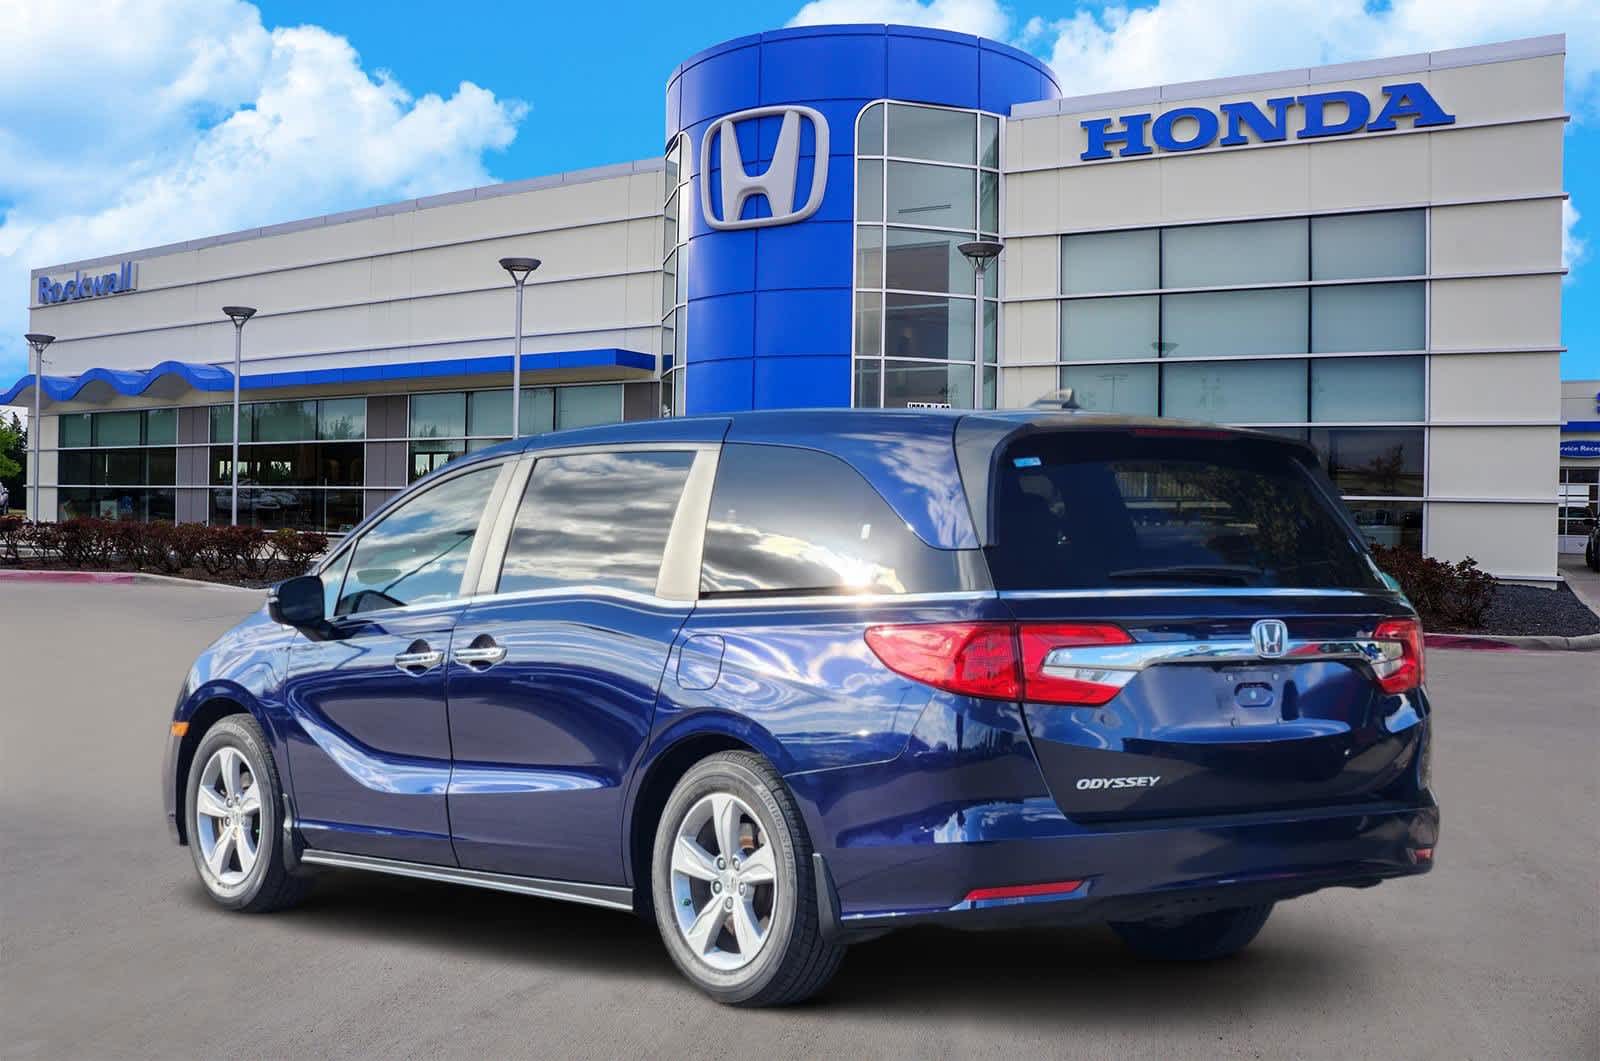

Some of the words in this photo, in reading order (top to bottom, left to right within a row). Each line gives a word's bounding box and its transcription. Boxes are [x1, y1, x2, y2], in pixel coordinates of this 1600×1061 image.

[1080, 82, 1456, 161] HONDA
[38, 261, 132, 304] Rockwall
[1076, 776, 1160, 790] ODYSSEY
